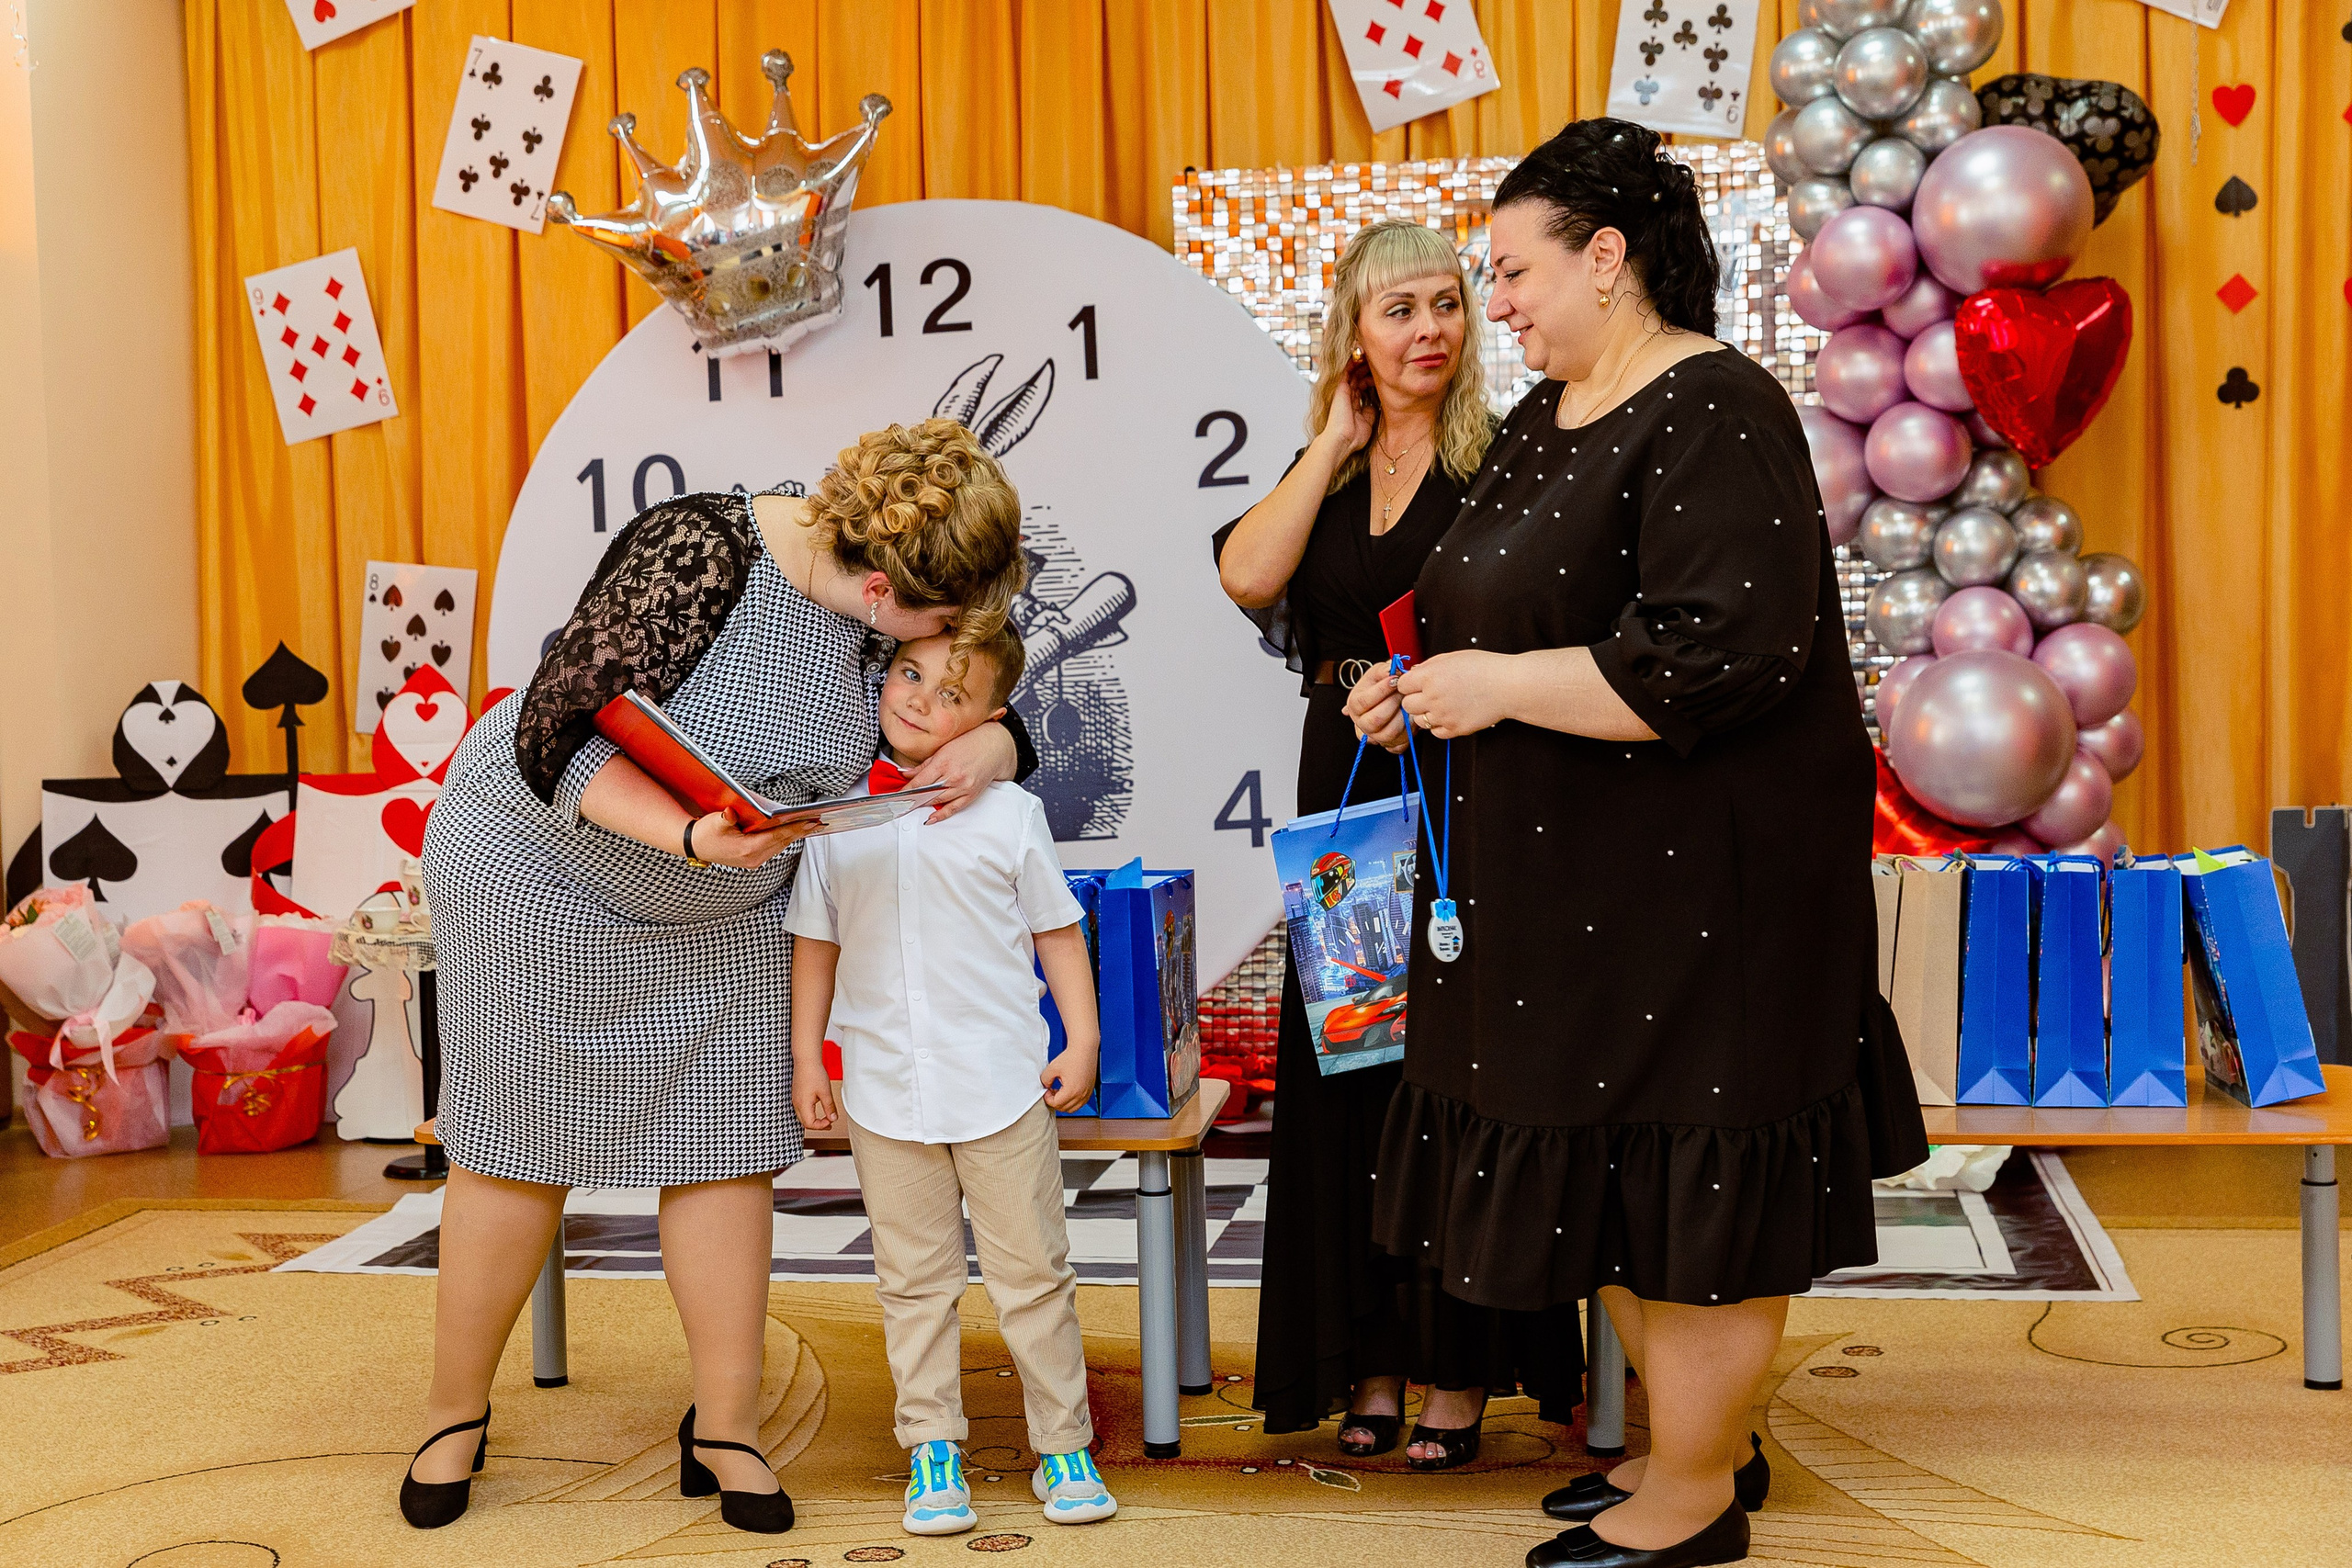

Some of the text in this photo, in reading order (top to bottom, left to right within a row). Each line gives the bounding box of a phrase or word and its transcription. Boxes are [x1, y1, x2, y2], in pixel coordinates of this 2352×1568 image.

[864, 258, 973, 337] 12
[1068, 305, 1099, 379] 1
[1195, 411, 1250, 488] 2
[576, 454, 685, 533] 10
[368, 572, 379, 591] 8
[1214, 770, 1272, 847] 4
